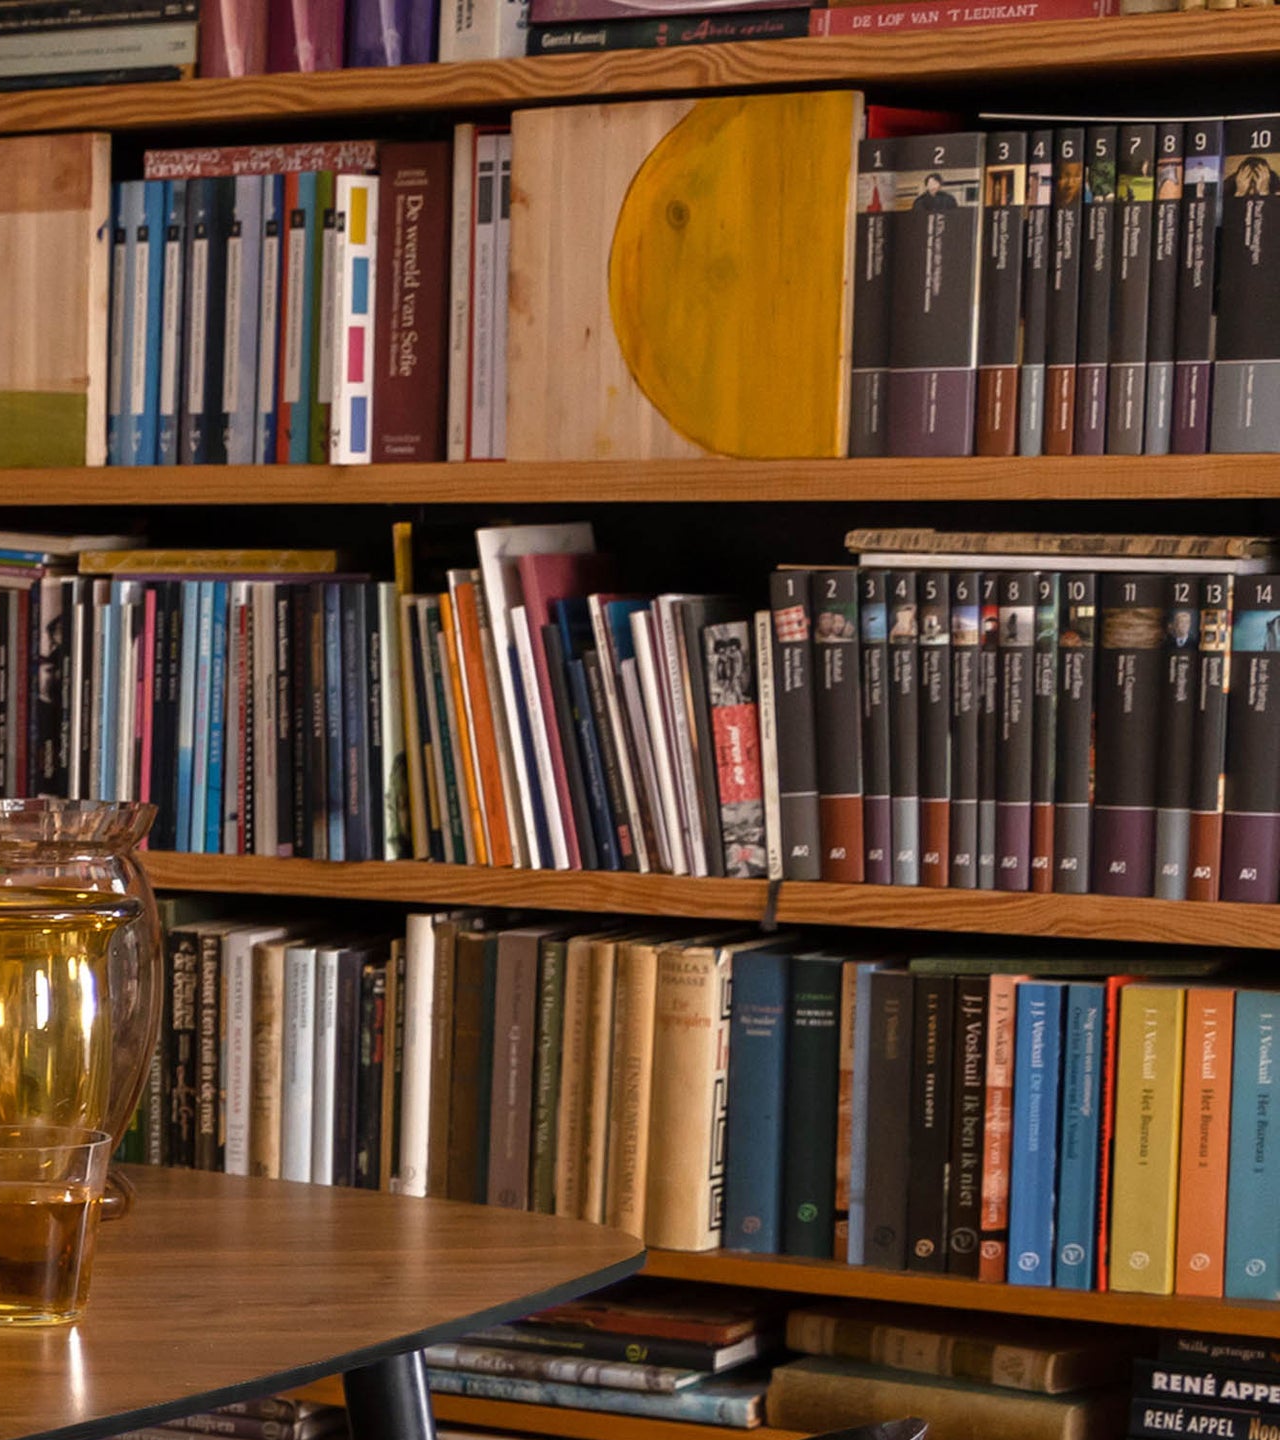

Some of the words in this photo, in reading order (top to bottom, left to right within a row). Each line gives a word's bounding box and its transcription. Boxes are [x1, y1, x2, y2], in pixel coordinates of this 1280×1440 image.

[854, 16, 872, 27] DE
[878, 14, 904, 26] LOF
[912, 12, 939, 23] VAN
[964, 5, 1037, 20] LEDIKANT
[1062, 140, 1073, 158] 6
[1096, 137, 1107, 157] 5
[1130, 136, 1142, 155] 7
[1165, 134, 1175, 154] 8
[1196, 131, 1207, 151] 9
[1251, 128, 1271, 150] 10
[873, 151, 883, 168] 1
[934, 146, 945, 165] 2
[999, 142, 1009, 160] 3
[1033, 142, 1045, 159] 4
[406, 195, 424, 221] De
[403, 226, 421, 289] wereld
[400, 294, 416, 329] van
[398, 331, 418, 377] Sofie
[786, 579, 795, 597] 1
[827, 579, 838, 598] 2
[866, 579, 877, 598] 3
[896, 580, 907, 598] 4
[926, 580, 938, 599] 5
[956, 581, 968, 600] 6
[983, 581, 994, 599] 7
[1008, 582, 1019, 601] 8
[1040, 582, 1050, 601] 9
[1068, 582, 1085, 601] 10
[1125, 583, 1137, 602] 11
[1174, 583, 1191, 603] 12
[1207, 584, 1224, 604] 13
[1256, 585, 1273, 604] 14
[961, 995, 983, 1017] J.J.
[1030, 1001, 1046, 1018] J.J.
[994, 1018, 1009, 1066] Voskuil
[1030, 1021, 1045, 1069] Voskuil
[963, 1021, 983, 1087] Voskuil
[1141, 1031, 1156, 1079] Voskuil
[1201, 1031, 1216, 1079] Voskuil
[1257, 1036, 1272, 1084] Voskuil
[1029, 1073, 1042, 1090] De
[962, 1095, 980, 1113] Ik
[1140, 1088, 1154, 1110] Het
[1200, 1088, 1214, 1110] Het
[1256, 1093, 1270, 1115] Het
[960, 1117, 981, 1148] ben
[1028, 1093, 1043, 1152] buurman
[1138, 1114, 1153, 1158] Bureau
[1198, 1114, 1213, 1158] Bureau
[1254, 1119, 1269, 1163] Bureau
[961, 1151, 979, 1168] ik
[990, 1146, 1002, 1168] van
[959, 1173, 979, 1208] niet
[1151, 1371, 1218, 1398] RENÉ
[1221, 1379, 1280, 1404] APPE
[1143, 1408, 1186, 1432] RENÉ
[1186, 1415, 1236, 1439] APPEL
